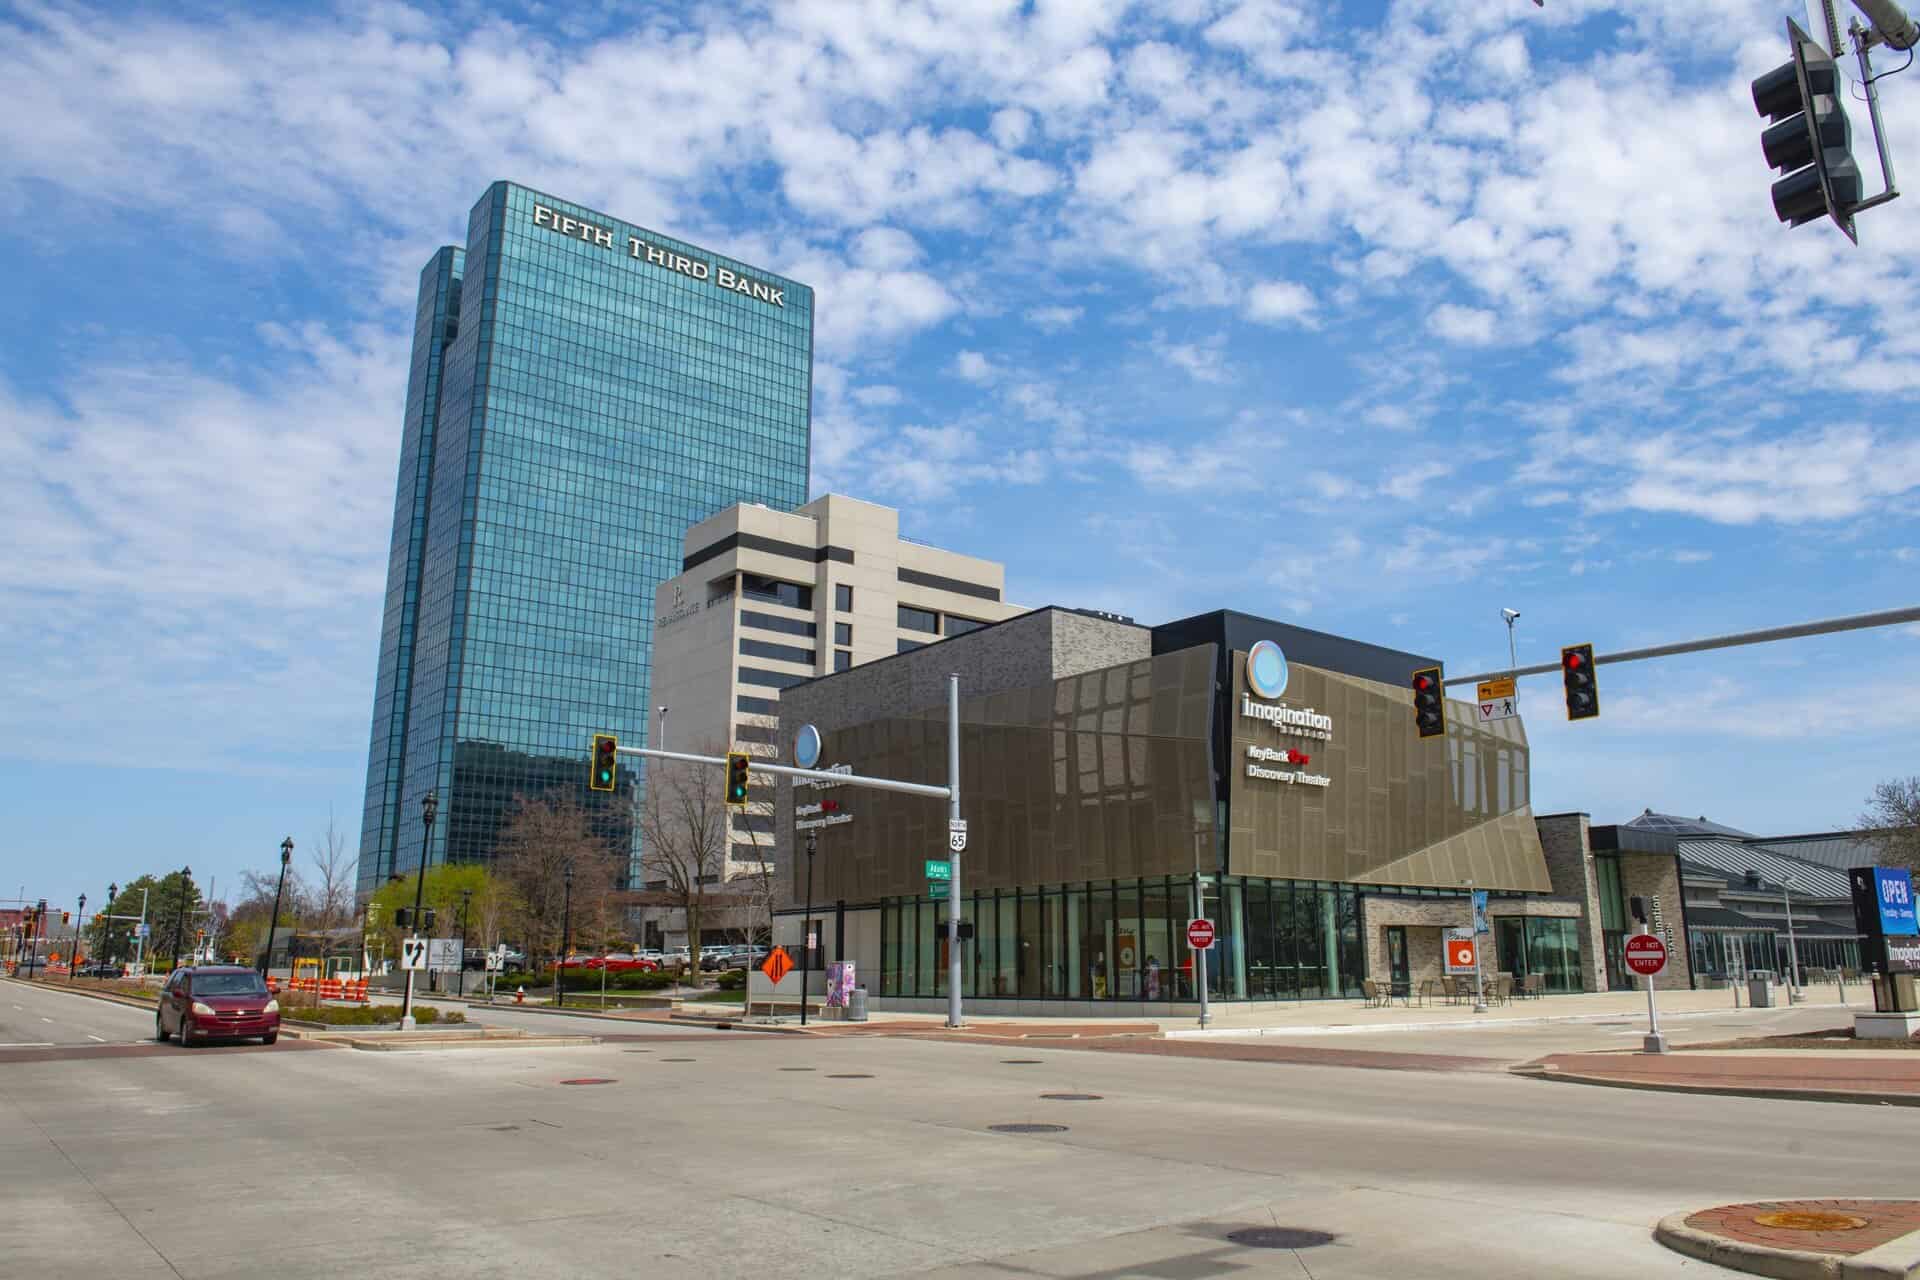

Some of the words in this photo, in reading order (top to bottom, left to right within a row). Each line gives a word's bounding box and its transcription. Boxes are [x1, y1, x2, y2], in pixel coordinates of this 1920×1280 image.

[534, 204, 614, 249] FIFTH
[629, 237, 708, 279] THIRD
[717, 267, 784, 306] BANK
[1242, 692, 1332, 730] imagination
[1247, 765, 1295, 784] Discovery
[1296, 771, 1331, 786] Theater
[951, 835, 964, 847] 65
[1882, 880, 1908, 904] OPEN
